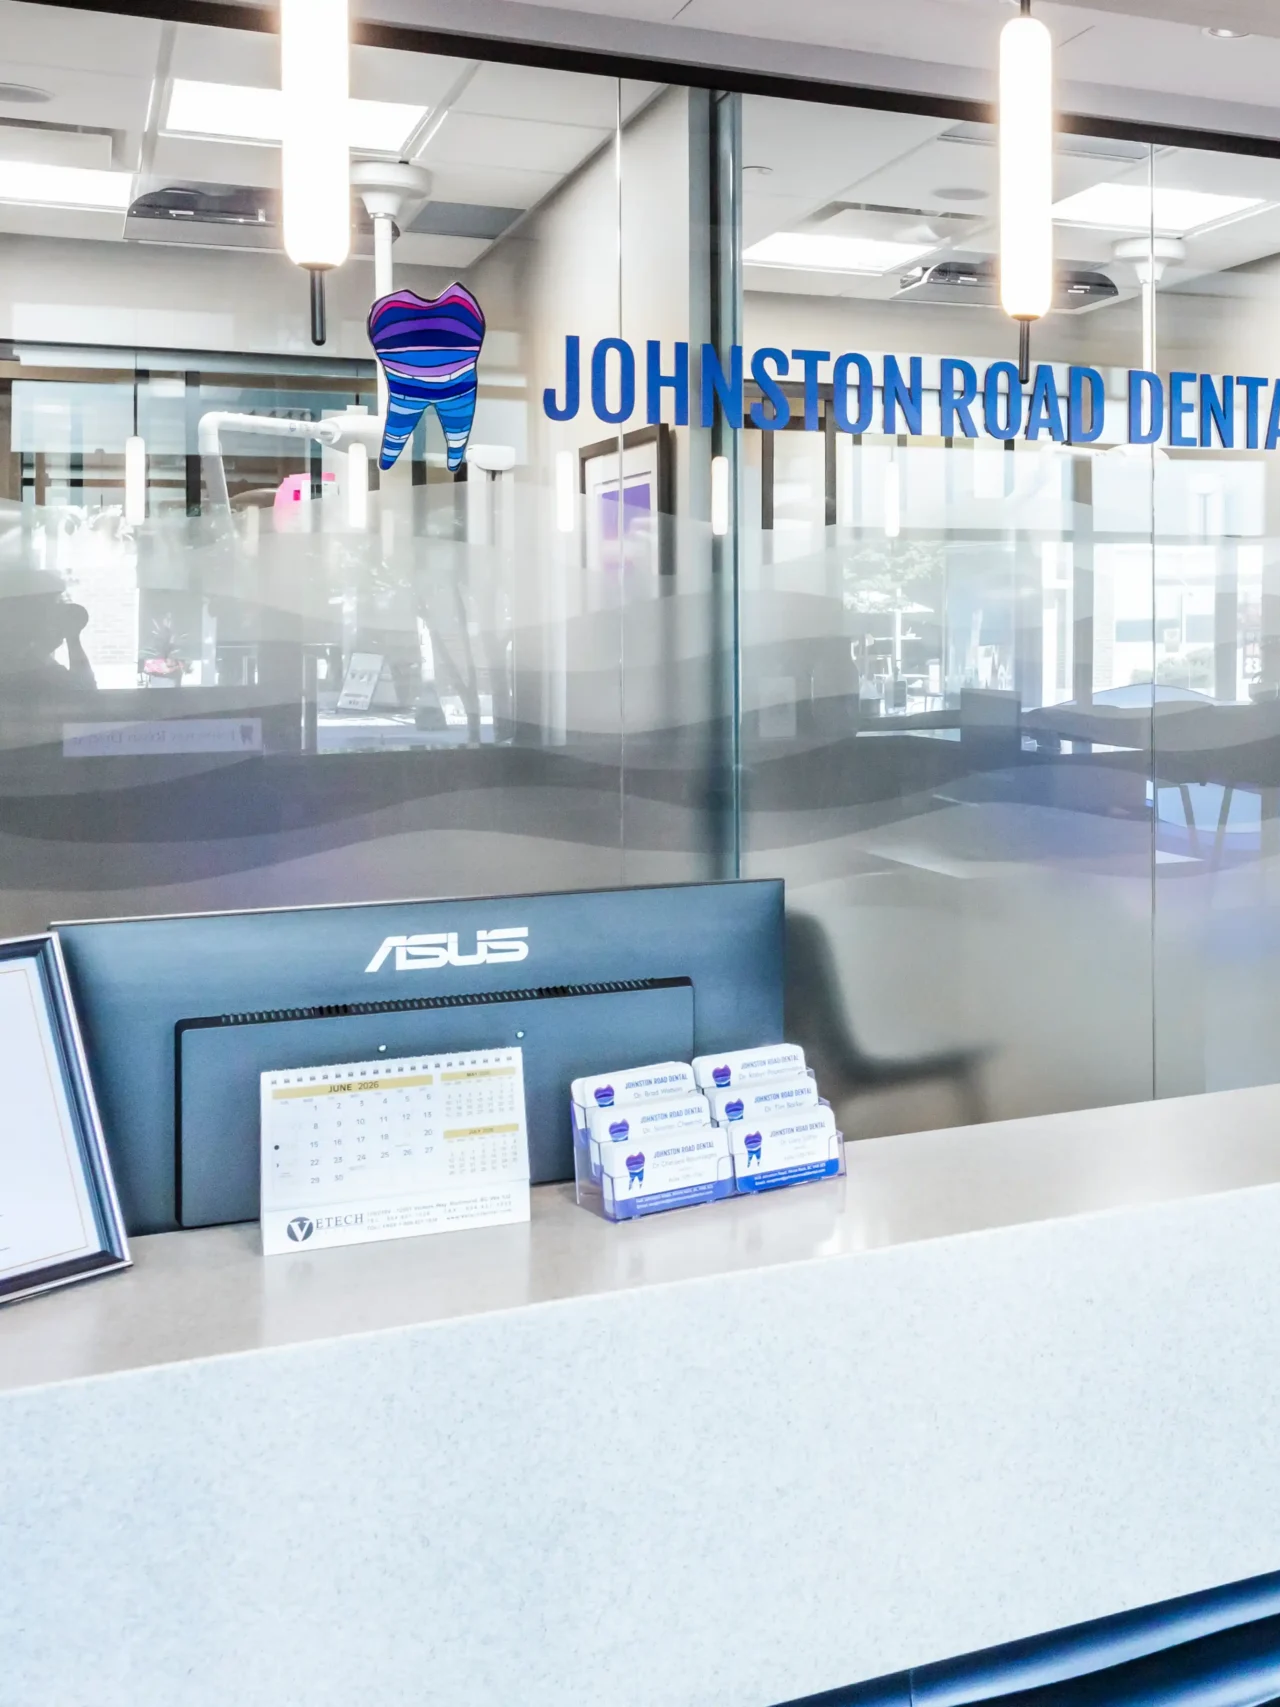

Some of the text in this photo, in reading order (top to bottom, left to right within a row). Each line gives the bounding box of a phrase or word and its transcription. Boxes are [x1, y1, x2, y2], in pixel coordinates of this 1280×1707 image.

[543, 335, 922, 436] JOHNSTON
[940, 358, 1105, 443] ROAD
[364, 927, 529, 972] ASUS
[741, 1054, 799, 1070] JOHNSTON ROAD DENTAL
[328, 1083, 352, 1093] JUNE
[357, 1080, 379, 1090] 2026
[625, 1073, 688, 1090] JOHNSTON ROAD DENTAL
[754, 1088, 812, 1104] JOHNSTON ROAD DENTAL
[640, 1106, 703, 1124] JOHNSTON ROAD DENTAL
[770, 1121, 826, 1138] JOHNSTON ROAD DENTAL
[654, 1141, 714, 1159] JOHNSTON ROAD DENTAL
